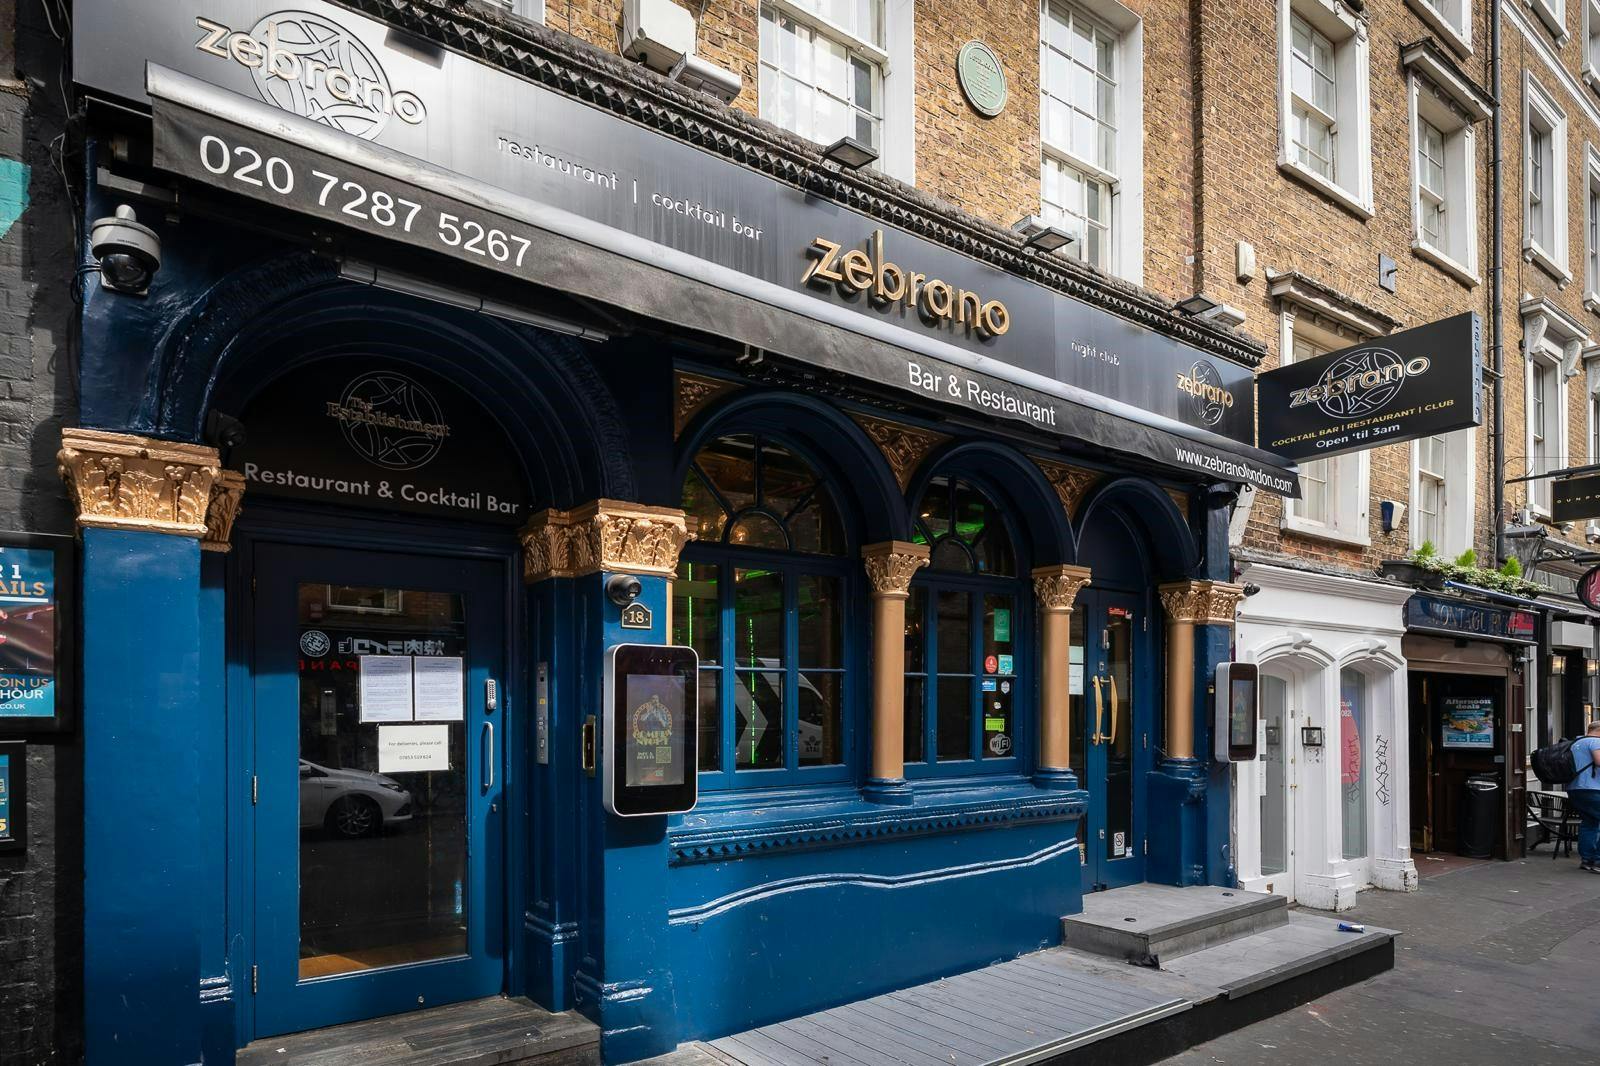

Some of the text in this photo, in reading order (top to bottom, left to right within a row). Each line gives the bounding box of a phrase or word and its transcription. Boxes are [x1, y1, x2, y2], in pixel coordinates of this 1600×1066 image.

[196, 17, 427, 124] zebrano
[200, 135, 532, 267] 020 7287 5267
[498, 136, 763, 241] restaurant cocktail bar
[803, 229, 1010, 336] zebrano
[1071, 337, 1120, 366] night club
[350, 396, 373, 411] The
[908, 362, 1056, 426] Bar & Restaurant
[1176, 366, 1234, 408] zebrano
[1289, 356, 1431, 409] zebrano
[326, 401, 451, 436] Establishment
[1271, 399, 1455, 447] COCKTAIL BAR RESTAURANT CLUB
[1316, 435, 1349, 449] Open
[1372, 423, 1400, 437] 3am
[244, 462, 520, 515] Restaurant & Cocktail Bar
[628, 610, 645, 624] 18
[0, 689, 44, 699] HOUR
[30, 678, 49, 687] US
